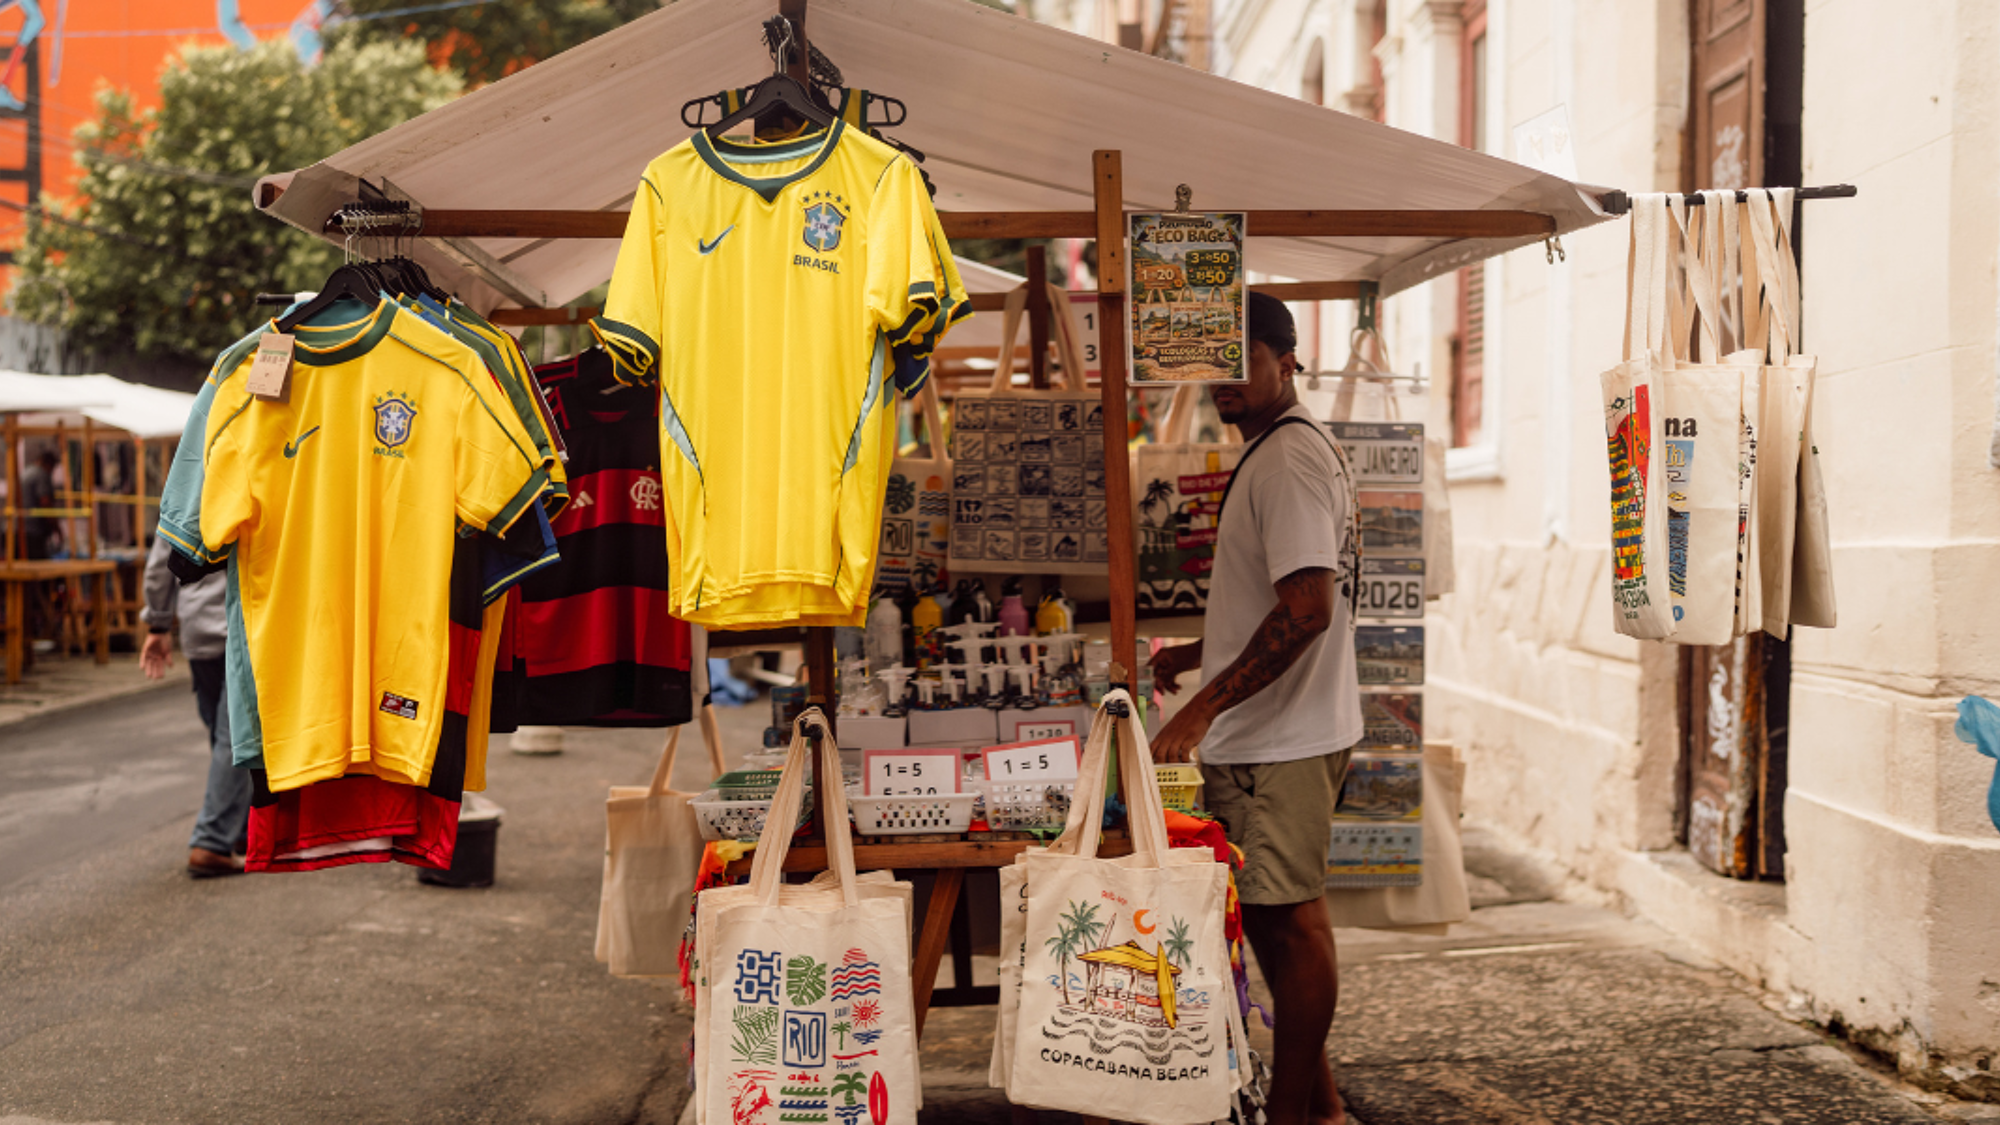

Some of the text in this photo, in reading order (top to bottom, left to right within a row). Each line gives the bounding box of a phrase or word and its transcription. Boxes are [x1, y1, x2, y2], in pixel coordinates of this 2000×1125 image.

[1155, 230, 1184, 244] ECO
[793, 254, 840, 275] BRASIL
[1190, 252, 1200, 264] 3
[1084, 312, 1094, 330] 1
[1085, 344, 1098, 362] 3
[1665, 417, 1698, 437] na
[1362, 446, 1419, 474] JANEIRO
[1359, 581, 1419, 609] 2026
[1362, 729, 1413, 743] ANEIRO
[883, 762, 891, 777] 1
[912, 762, 922, 777] 5
[1003, 759, 1012, 774] 1
[1039, 754, 1049, 770] 5
[788, 1018, 820, 1062] RIO
[1041, 1048, 1209, 1081] COPACABANA BEACH
